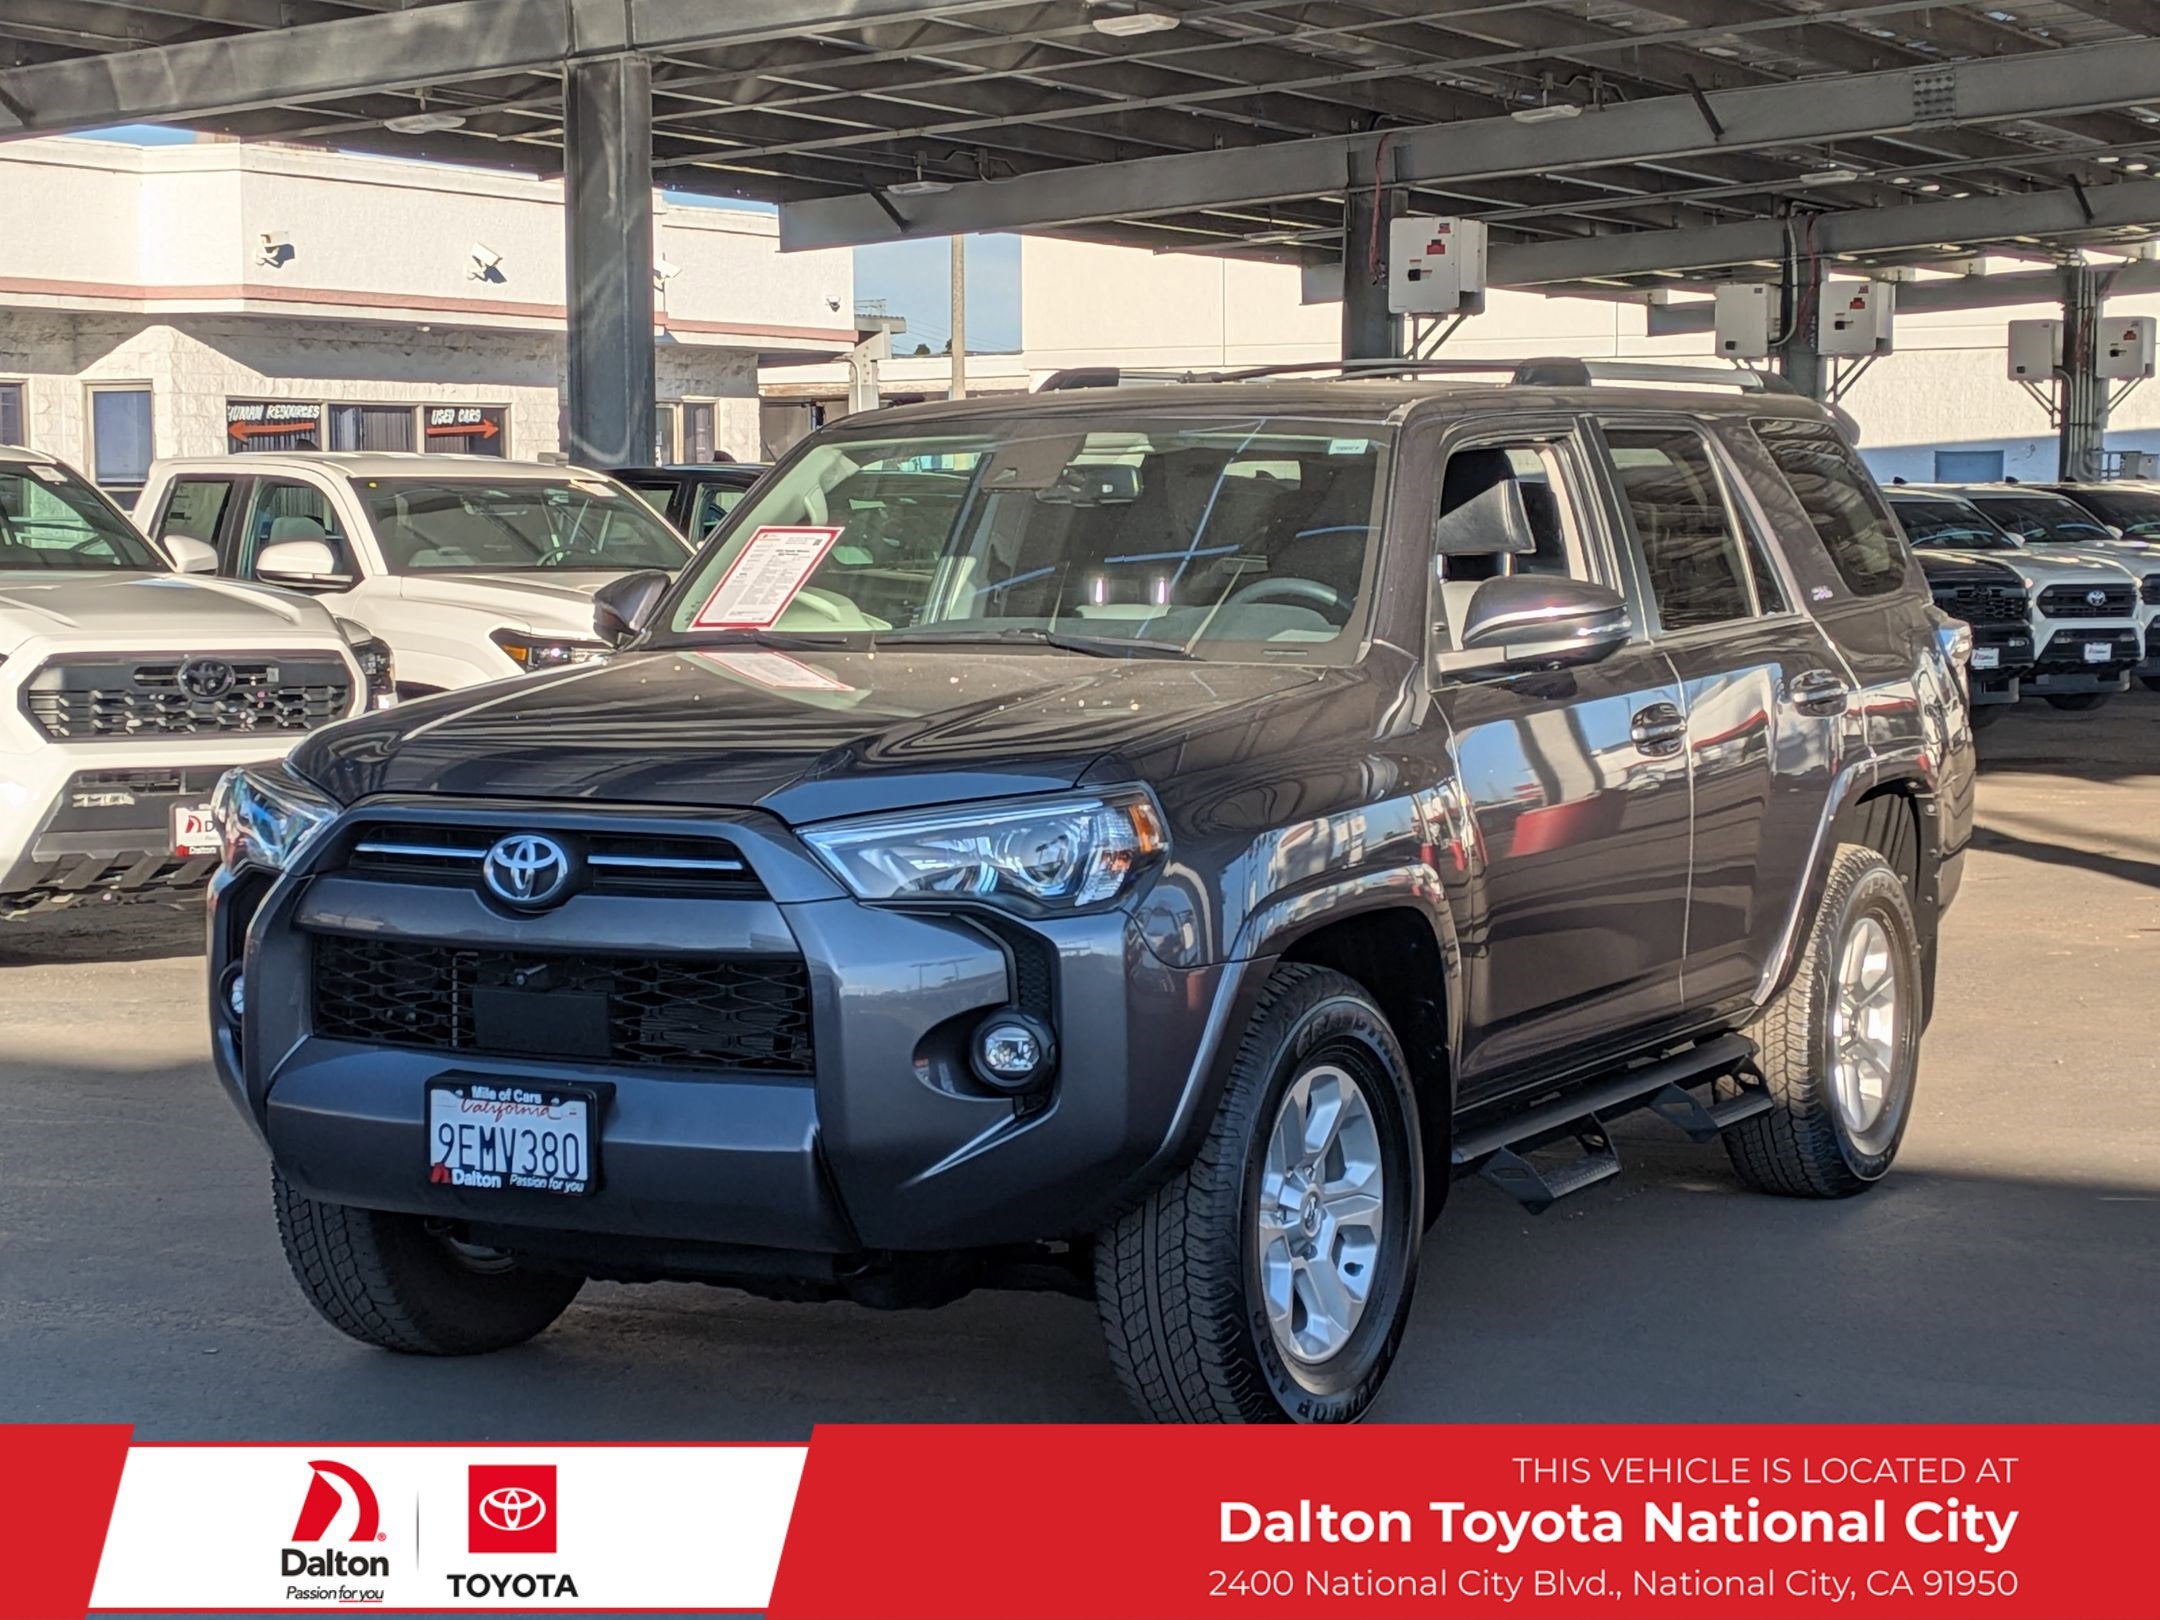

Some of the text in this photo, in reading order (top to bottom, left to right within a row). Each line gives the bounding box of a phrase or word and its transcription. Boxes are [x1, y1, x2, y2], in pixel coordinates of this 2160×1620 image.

[266, 404, 320, 419] RESOURCES
[431, 408, 481, 425] USED CARS
[471, 1085, 542, 1104] Mile of Cars
[461, 1098, 561, 1122] California
[438, 1122, 580, 1178] 9EMV380
[452, 1168, 584, 1193] Dalton Passion for you
